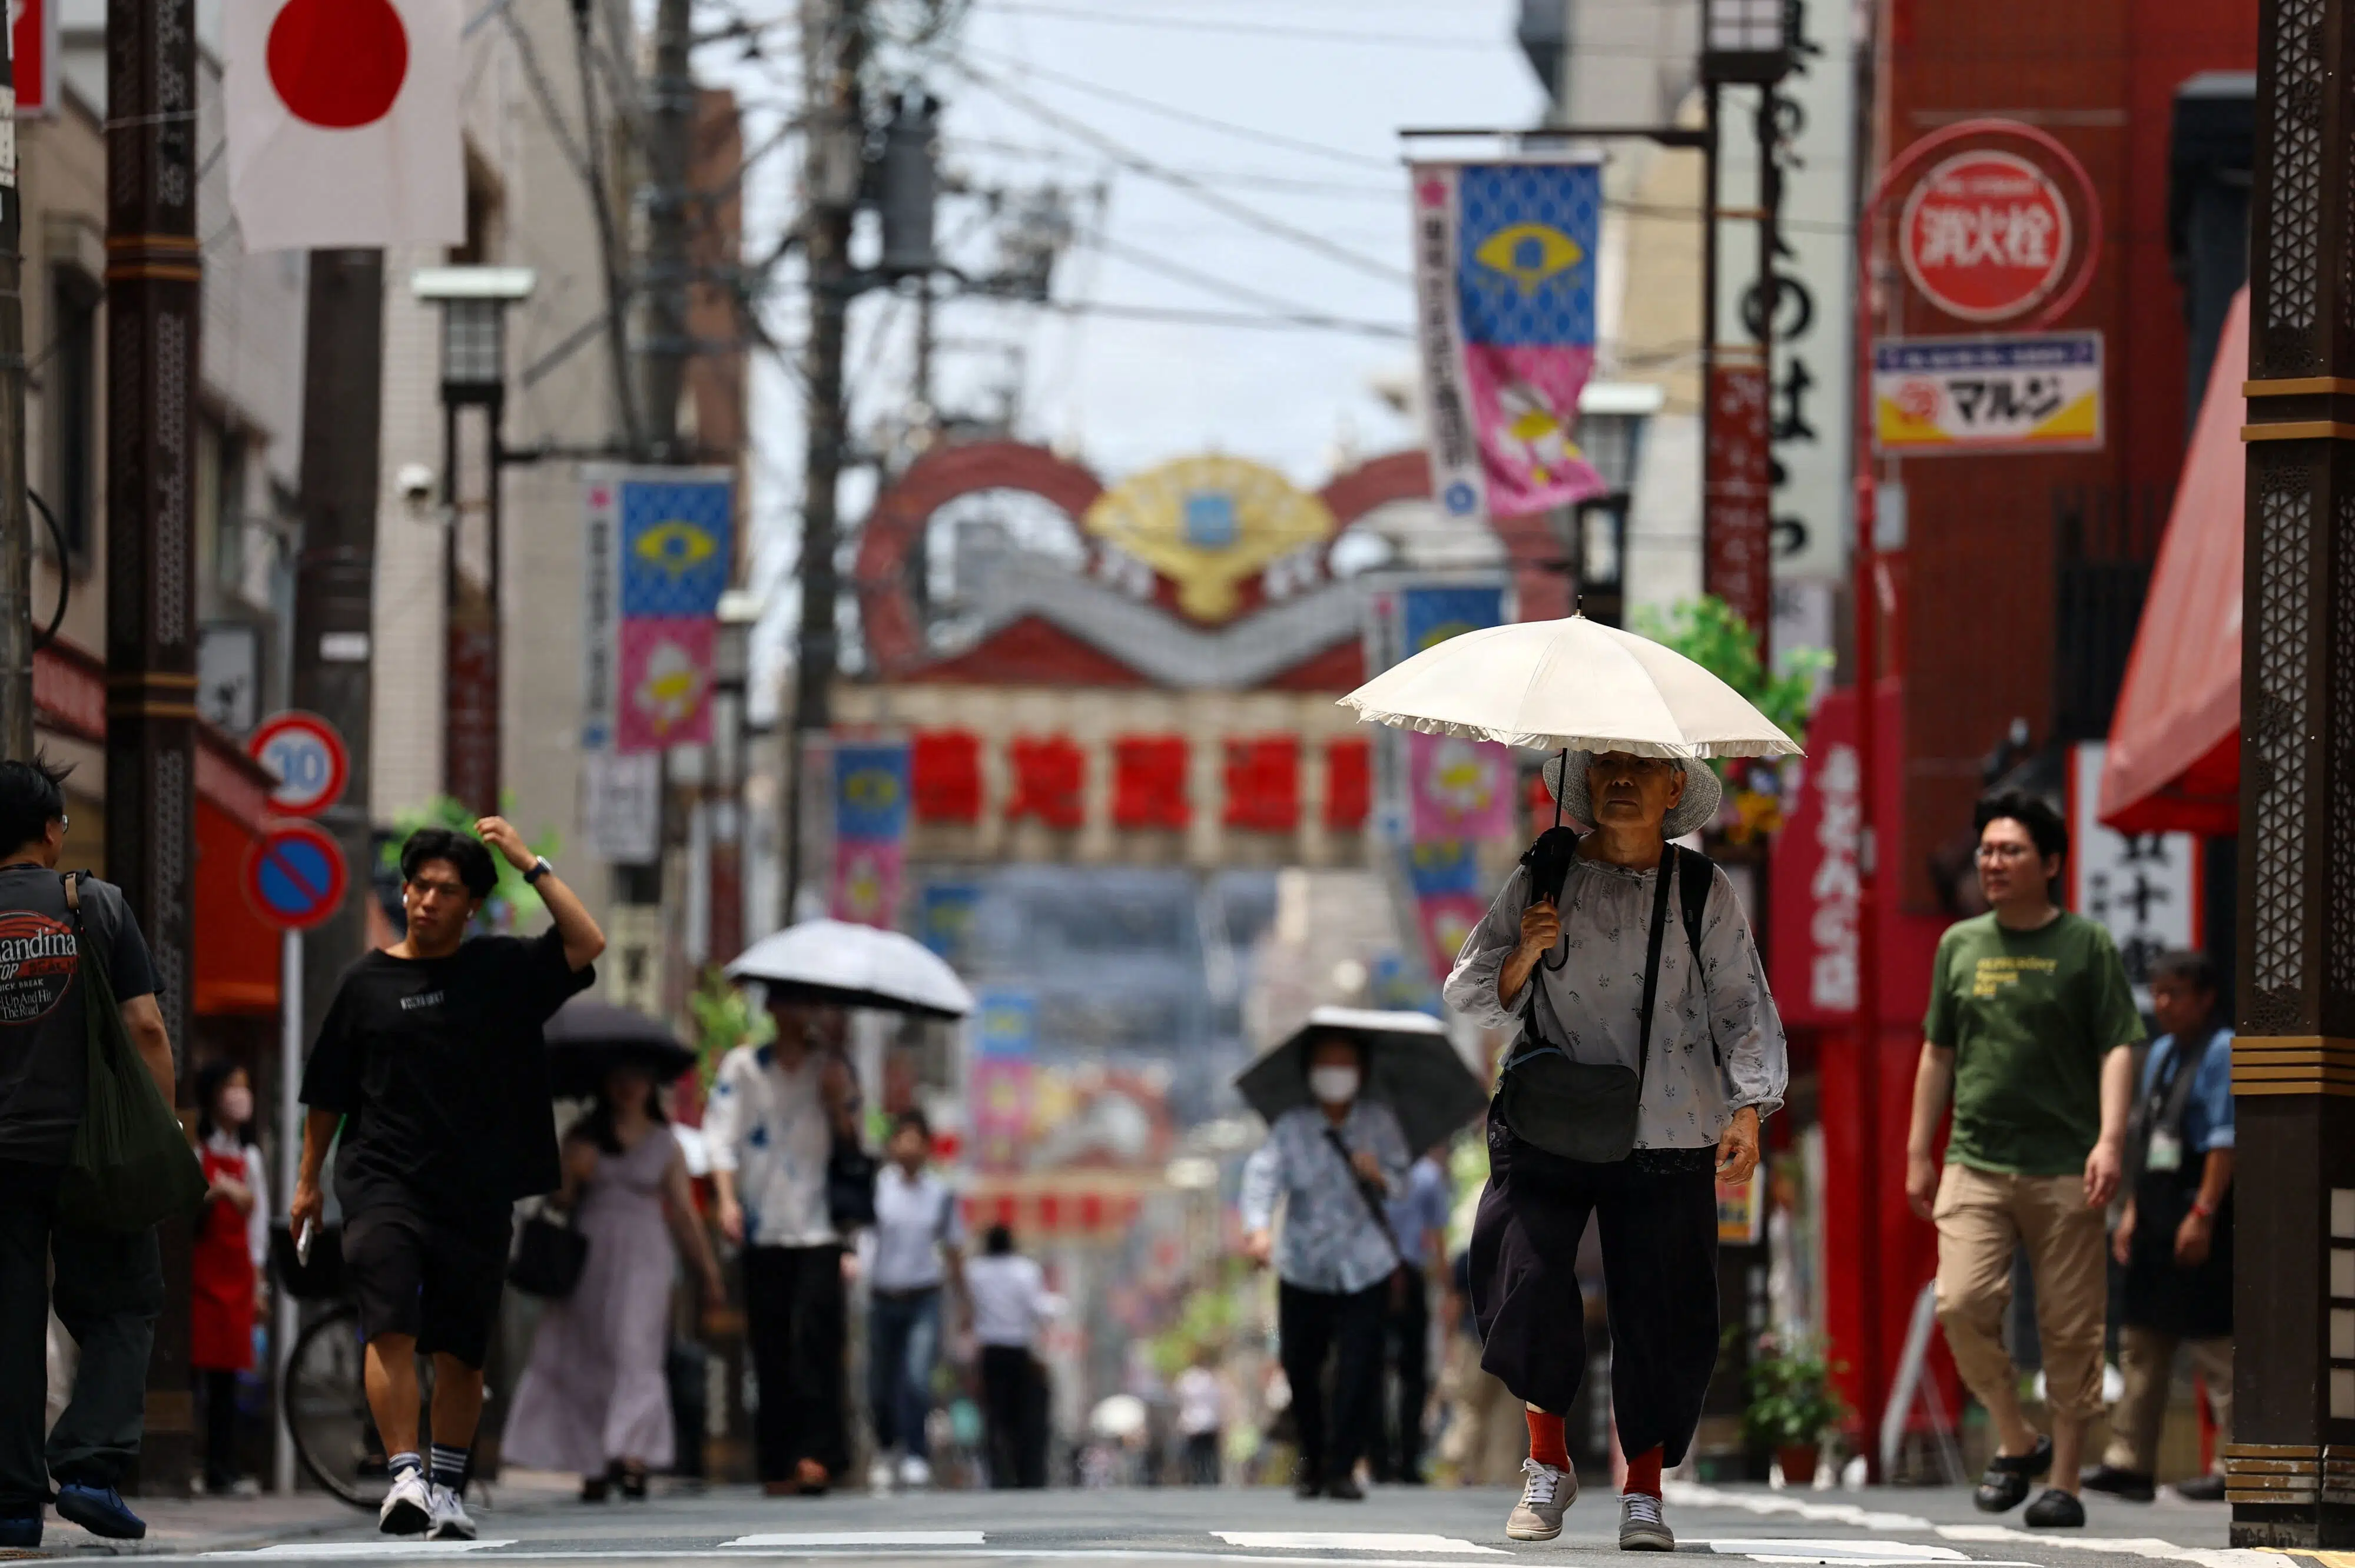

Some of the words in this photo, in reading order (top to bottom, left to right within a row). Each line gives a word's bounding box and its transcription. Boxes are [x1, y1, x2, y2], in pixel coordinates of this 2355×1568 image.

[0, 928, 77, 962] andina
[19, 978, 44, 989] BREAK
[21, 991, 37, 1005] And
[38, 989, 52, 1002] Hit
[2, 1006, 18, 1019] The
[19, 1004, 39, 1016] Road
